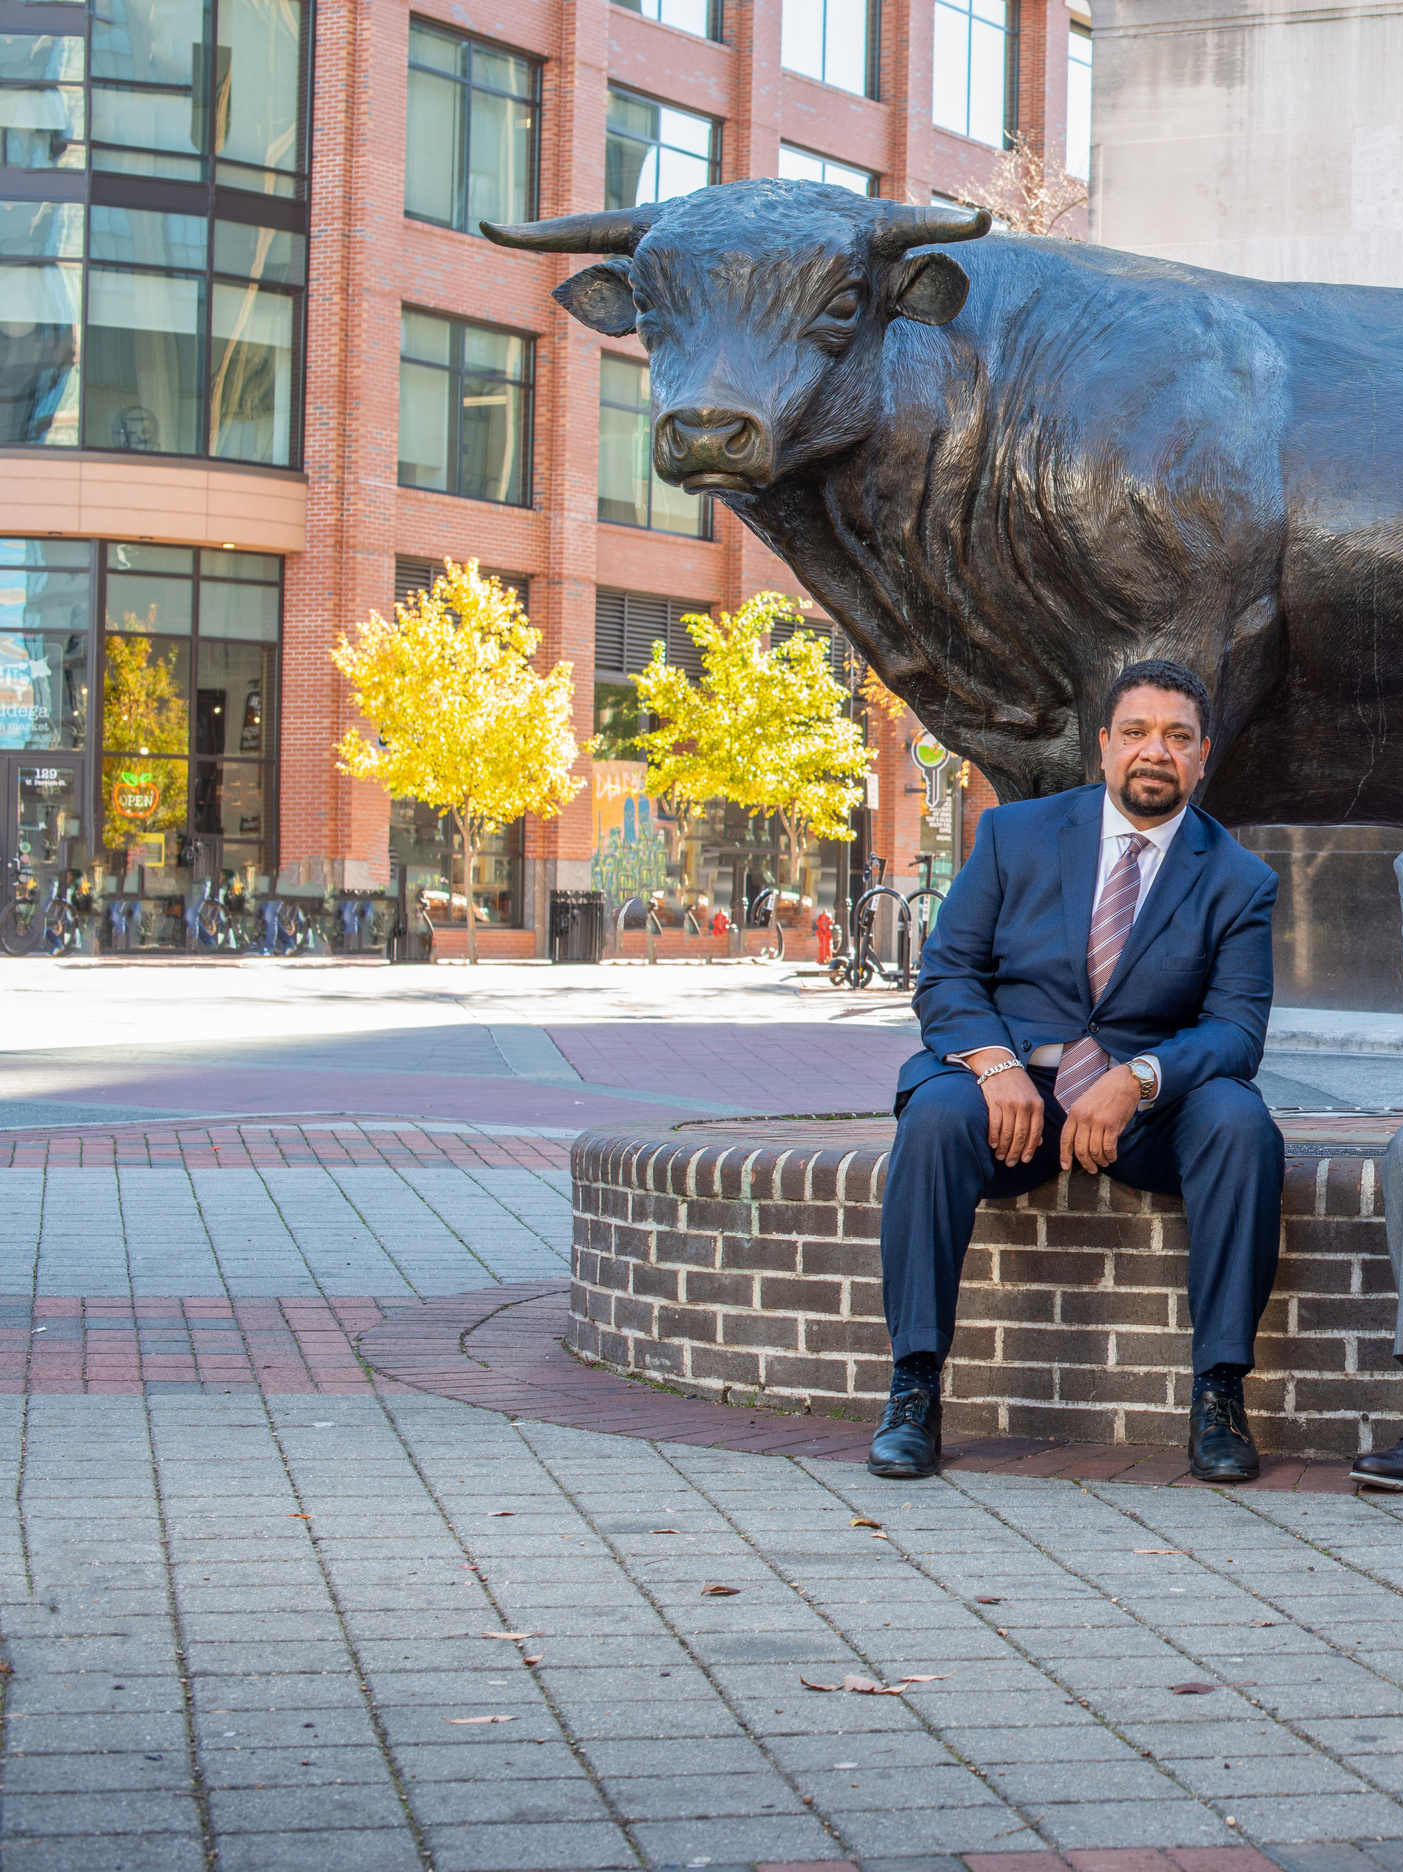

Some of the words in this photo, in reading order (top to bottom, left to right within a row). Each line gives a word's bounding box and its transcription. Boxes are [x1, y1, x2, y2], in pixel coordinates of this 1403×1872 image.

[8, 721, 50, 732] market
[35, 768, 57, 780] 129
[119, 794, 154, 807] OPEN
